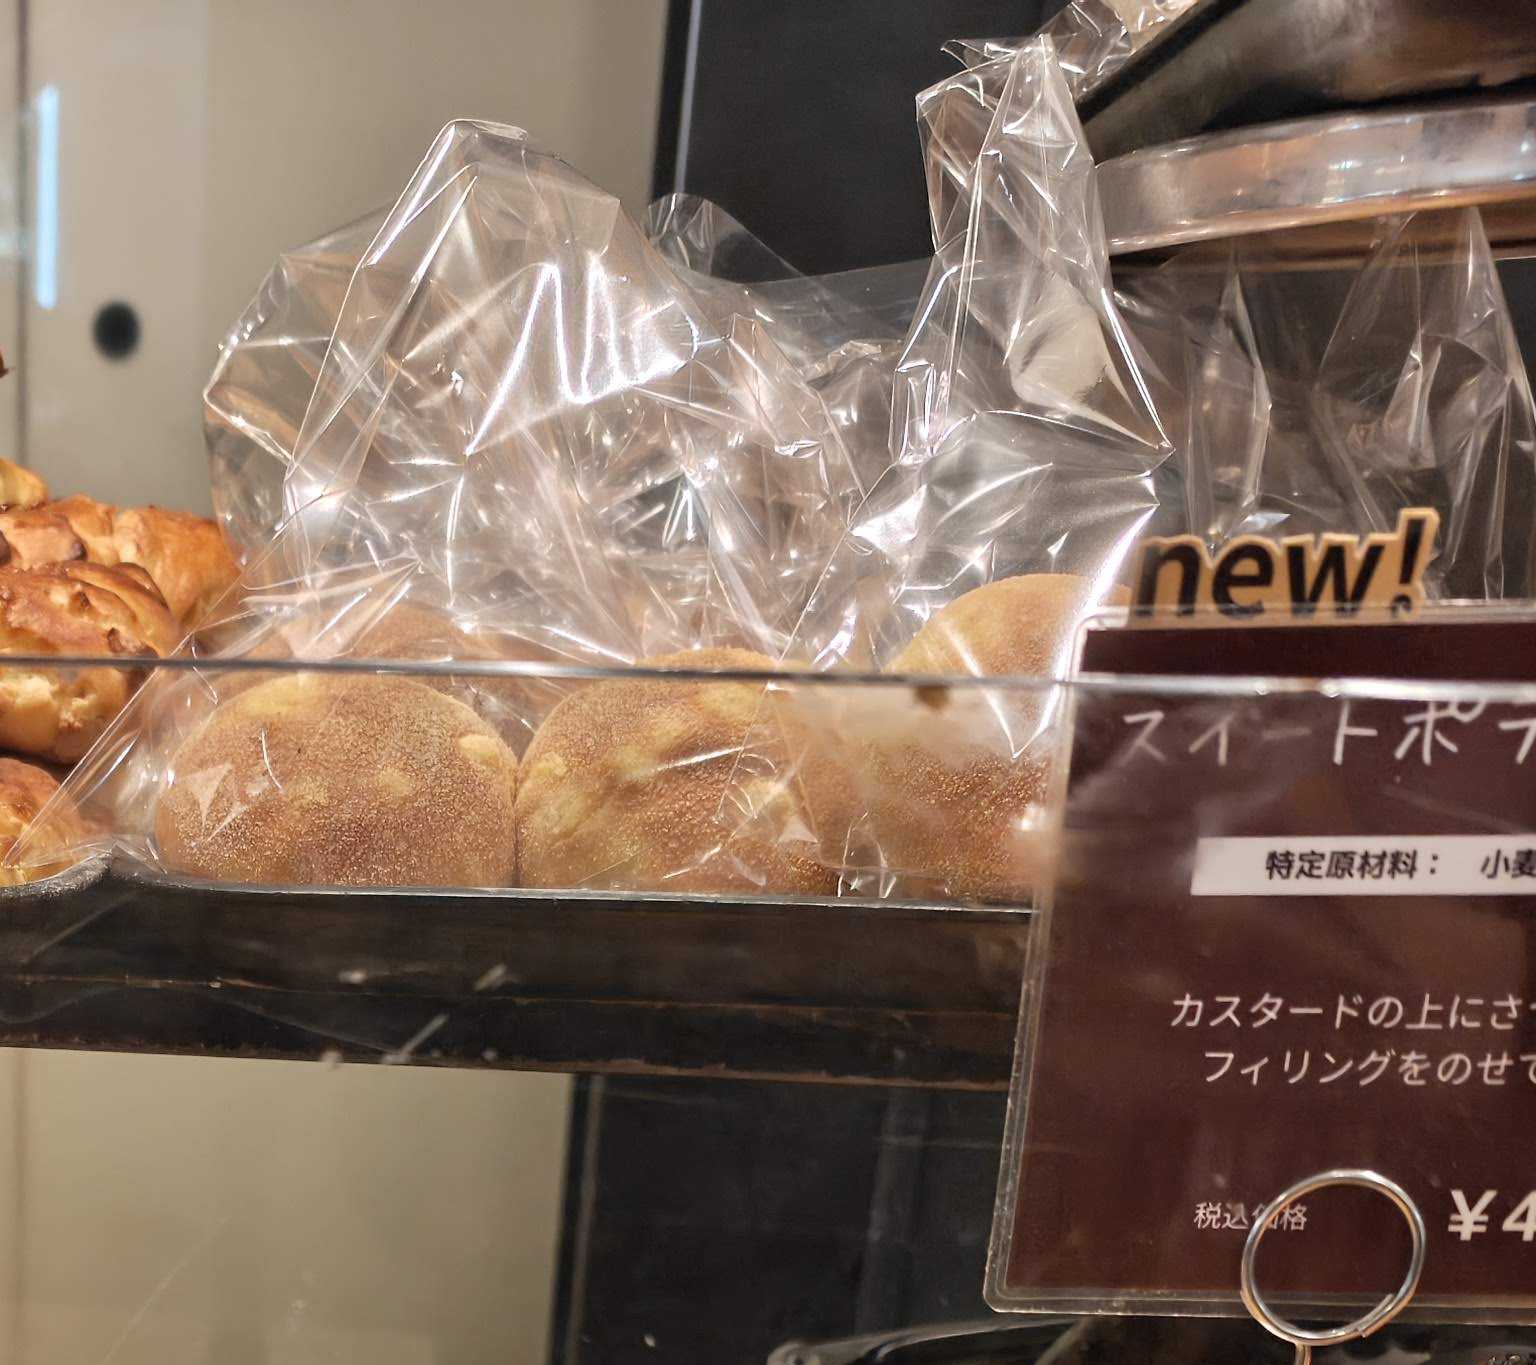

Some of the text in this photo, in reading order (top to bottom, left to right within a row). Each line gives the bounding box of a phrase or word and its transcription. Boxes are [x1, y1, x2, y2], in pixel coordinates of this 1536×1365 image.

[1134, 517, 1426, 618] new!
[1170, 992, 1536, 1030] カスタードの上にさ
